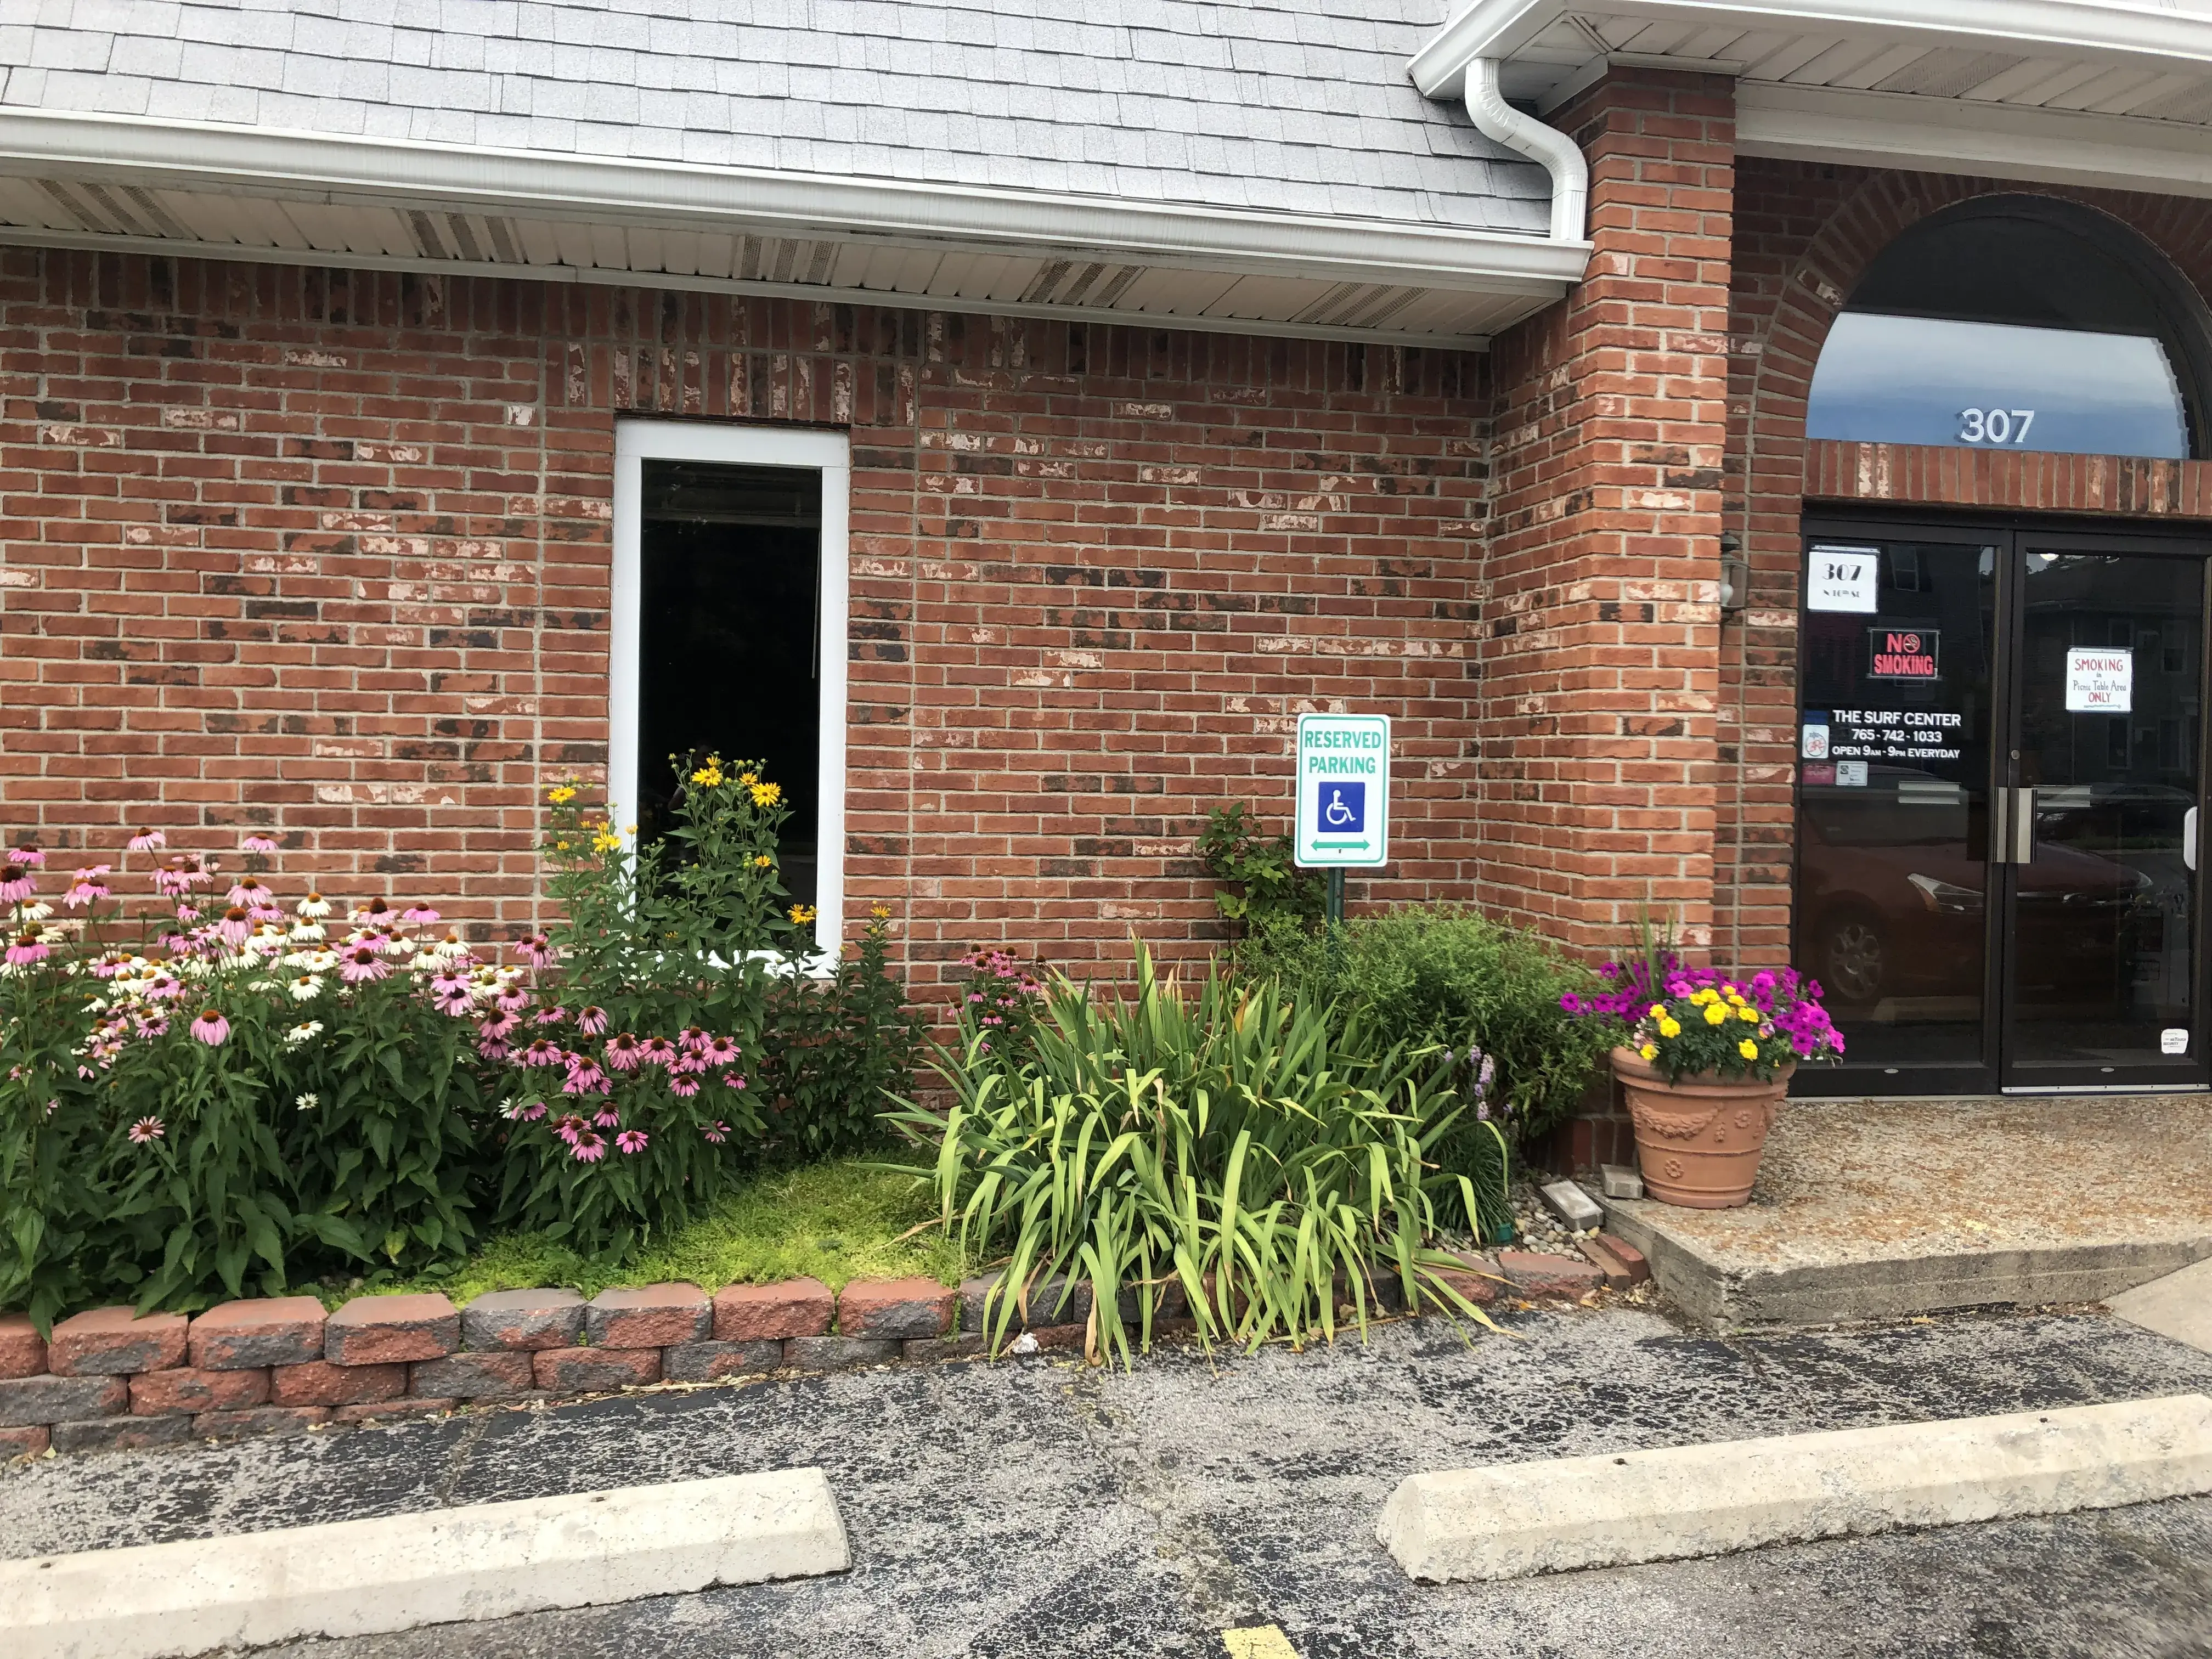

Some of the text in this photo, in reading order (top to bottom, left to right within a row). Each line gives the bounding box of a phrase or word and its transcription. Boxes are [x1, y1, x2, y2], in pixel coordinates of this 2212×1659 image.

[1961, 408, 2035, 443] 307
[1822, 563, 1863, 581] 307
[1887, 633, 1921, 653] NO
[1874, 654, 1933, 675] SMOKING
[2074, 658, 2124, 672] SMOKING
[2073, 680, 2127, 691] Picnic Table Area
[2088, 692, 2112, 703] ONLY
[1832, 709, 1962, 727] THE SURF CENTER
[1304, 730, 1381, 748] RESERVED
[1831, 745, 1861, 755] OPEN
[1907, 748, 1961, 759] EVERYDAY
[1308, 756, 1376, 774] PARKING
